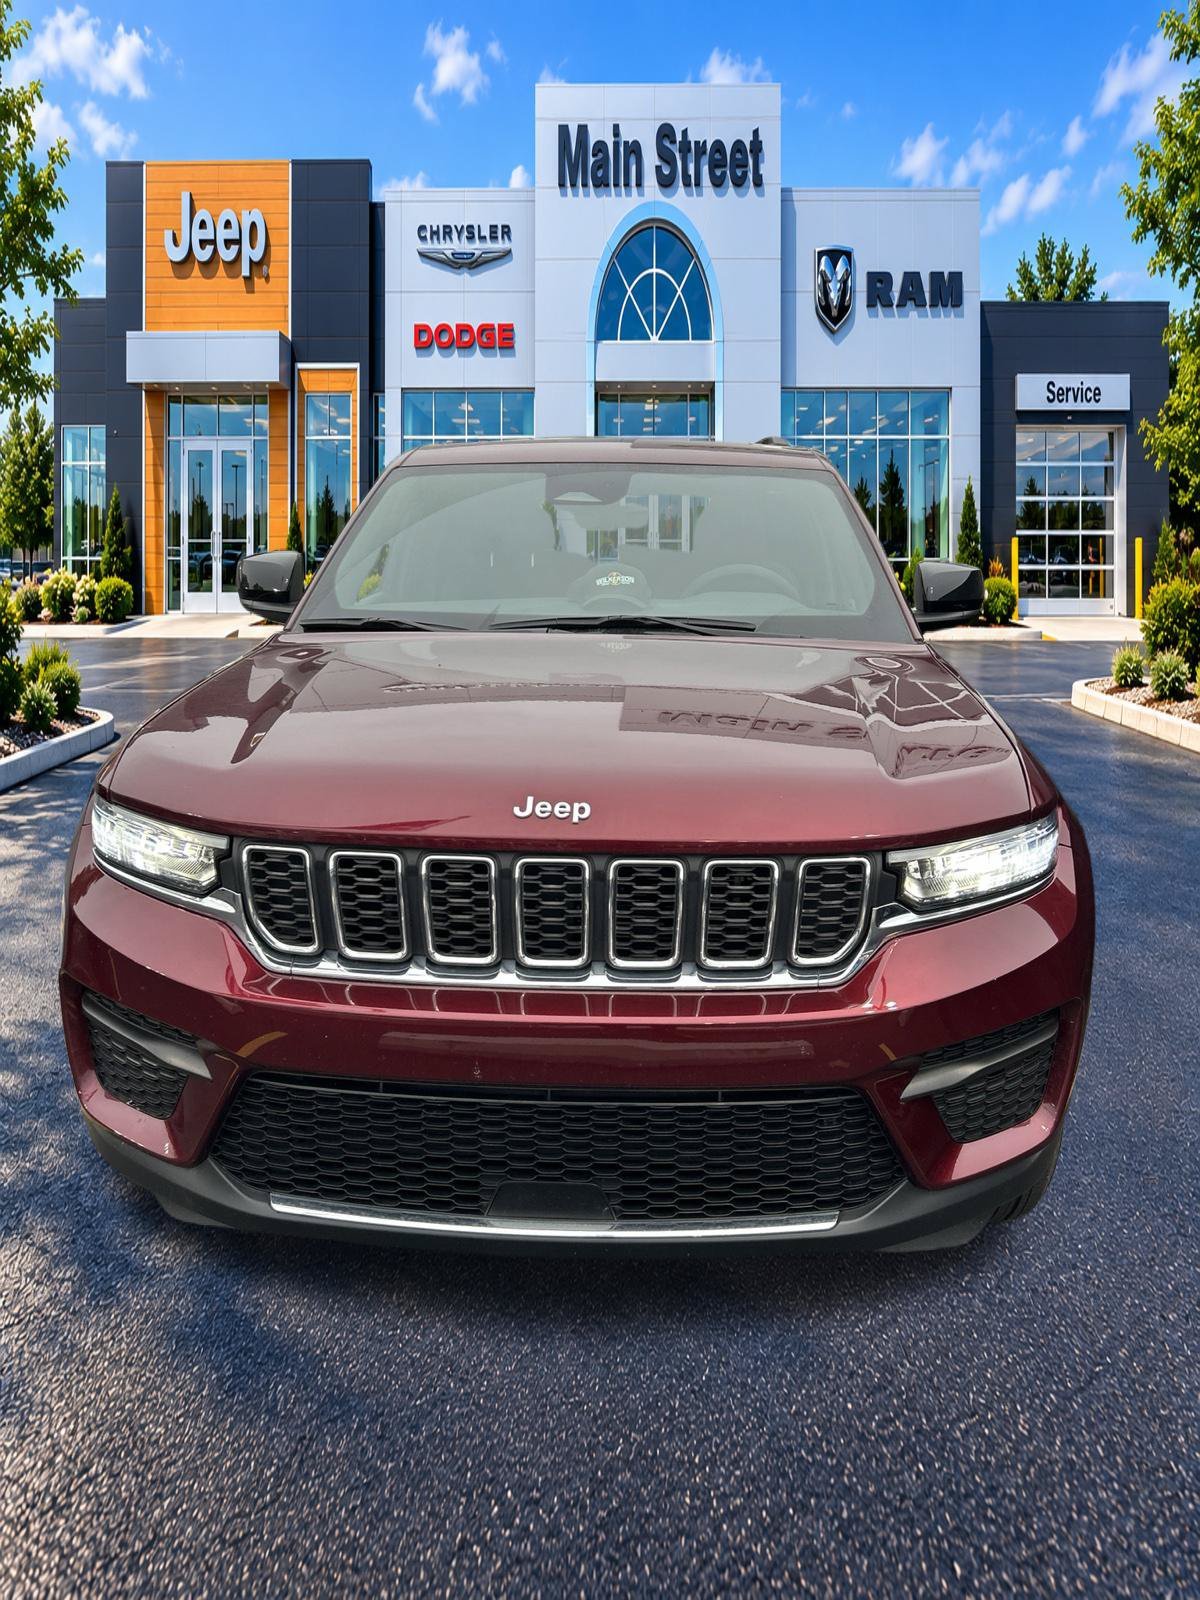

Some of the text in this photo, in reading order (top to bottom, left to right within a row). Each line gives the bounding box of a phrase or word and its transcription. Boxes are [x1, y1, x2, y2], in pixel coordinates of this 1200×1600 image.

[558, 122, 763, 188] Main Street
[164, 191, 267, 278] Jeep
[417, 224, 512, 242] CHRYSLER
[866, 271, 963, 308] RAM
[413, 323, 515, 349] DODGE
[1046, 381, 1102, 404] Service
[513, 796, 591, 824] Jeep
